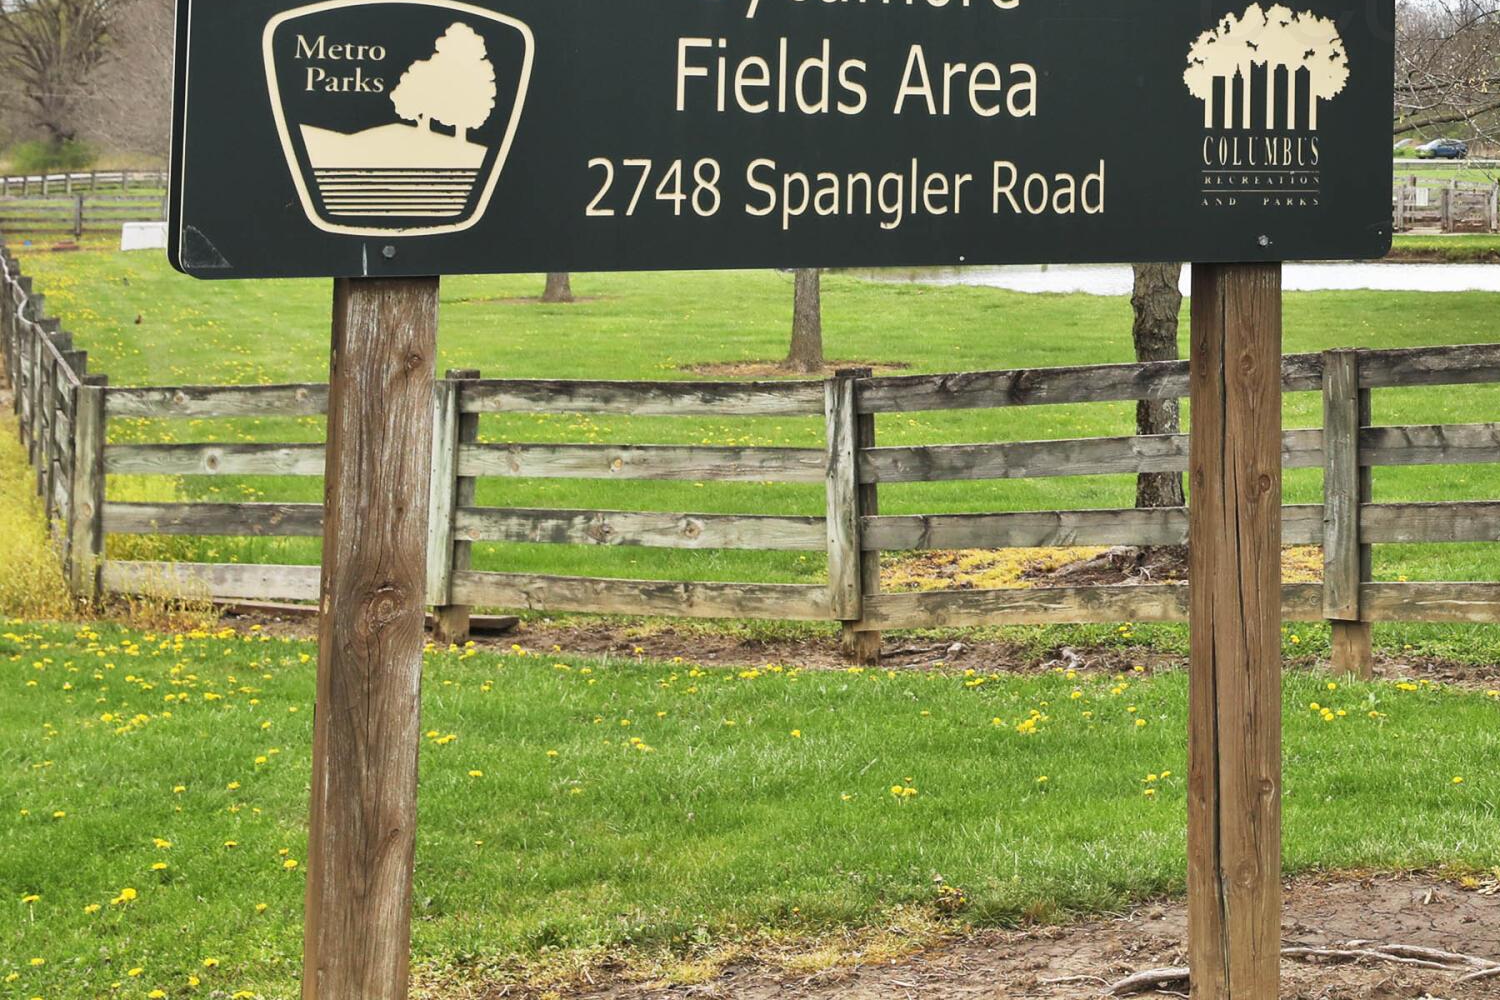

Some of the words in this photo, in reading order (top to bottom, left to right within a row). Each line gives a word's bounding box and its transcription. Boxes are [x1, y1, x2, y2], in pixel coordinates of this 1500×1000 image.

[293, 33, 387, 61] Metro
[304, 66, 385, 93] Parks
[676, 36, 868, 115] Fields
[892, 44, 1037, 118] Area
[1202, 135, 1320, 166] COLUMBUS
[585, 157, 721, 217] 2748
[745, 157, 973, 231] Spangler
[992, 158, 1105, 215] Road
[1203, 175, 1320, 186] RECREATION
[1200, 196, 1238, 207] AND
[1262, 196, 1320, 207] PARKS
